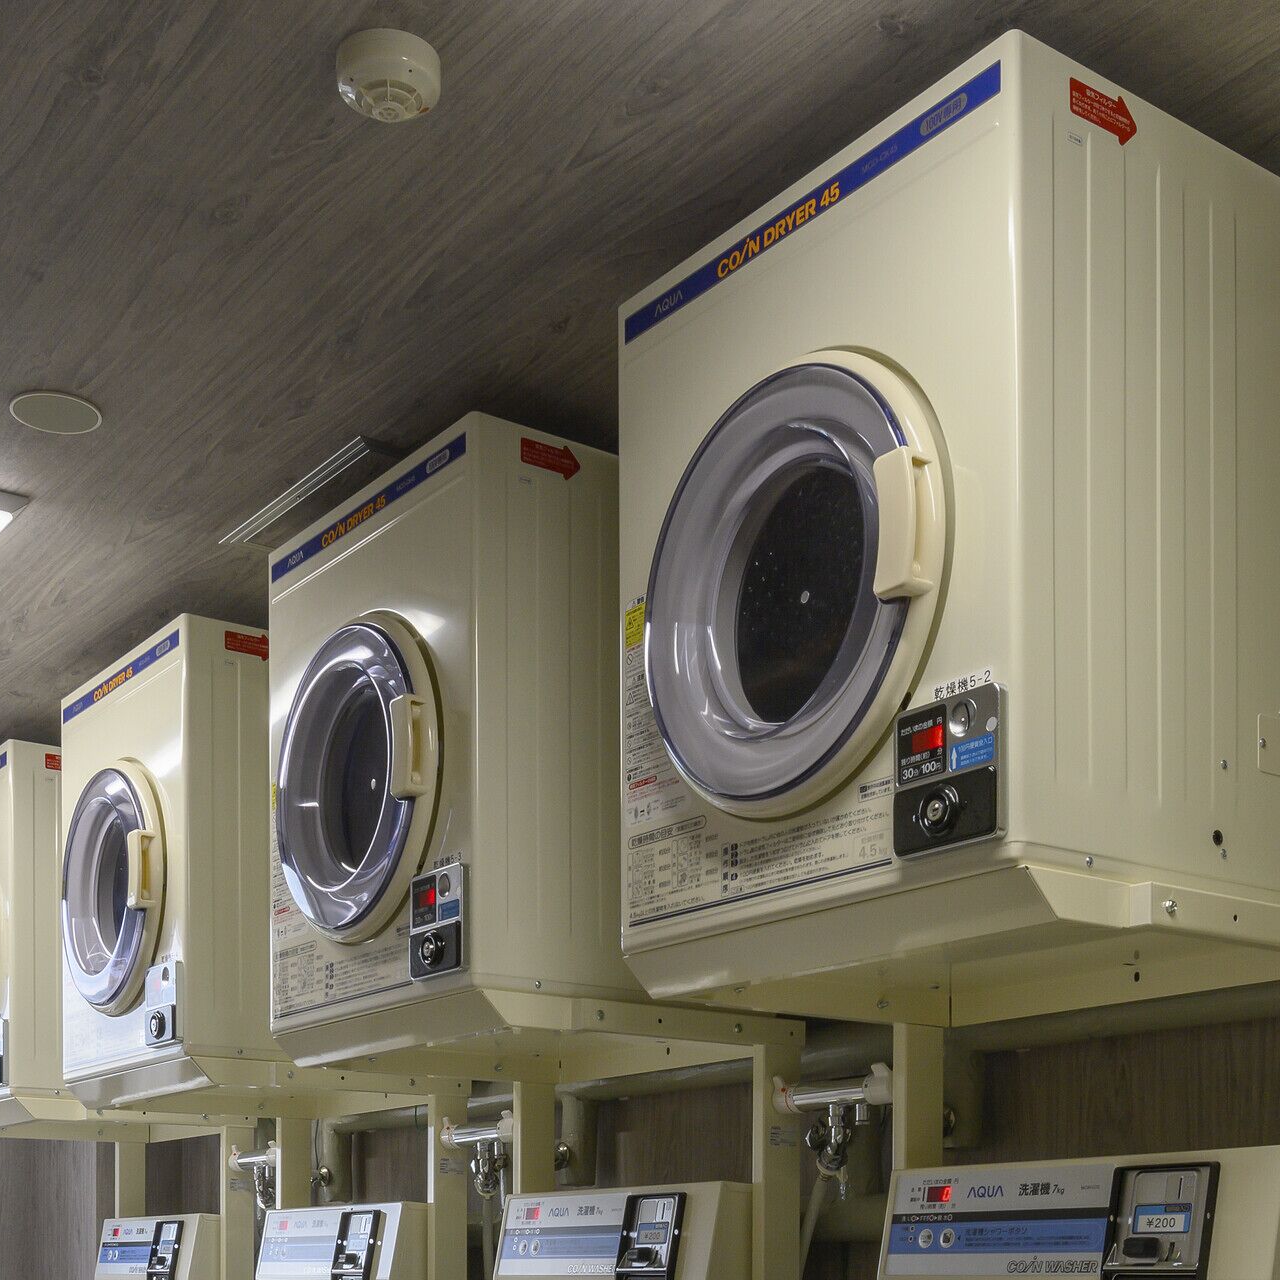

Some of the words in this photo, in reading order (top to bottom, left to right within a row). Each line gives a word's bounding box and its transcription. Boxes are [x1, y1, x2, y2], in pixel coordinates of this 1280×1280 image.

[654, 290, 683, 317] AQUA
[717, 237, 760, 279] COIN
[763, 199, 817, 248] DRYER
[820, 182, 840, 208] 45
[287, 550, 303, 568] AQUA
[321, 519, 346, 548] COIN
[347, 505, 374, 532] DRYER
[375, 495, 386, 510] 45
[934, 669, 991, 700] 乾燥機5-2
[942, 1187, 951, 1201] 0
[966, 1185, 1004, 1199] AQUA
[1018, 1183, 1050, 1196] 洗濯機
[1052, 1184, 1065, 1195] 7kg
[548, 1207, 570, 1217] AQUA
[1146, 1217, 1176, 1228] ¥200
[1007, 1256, 1043, 1273] COIN
[1045, 1260, 1099, 1274] WASHER
